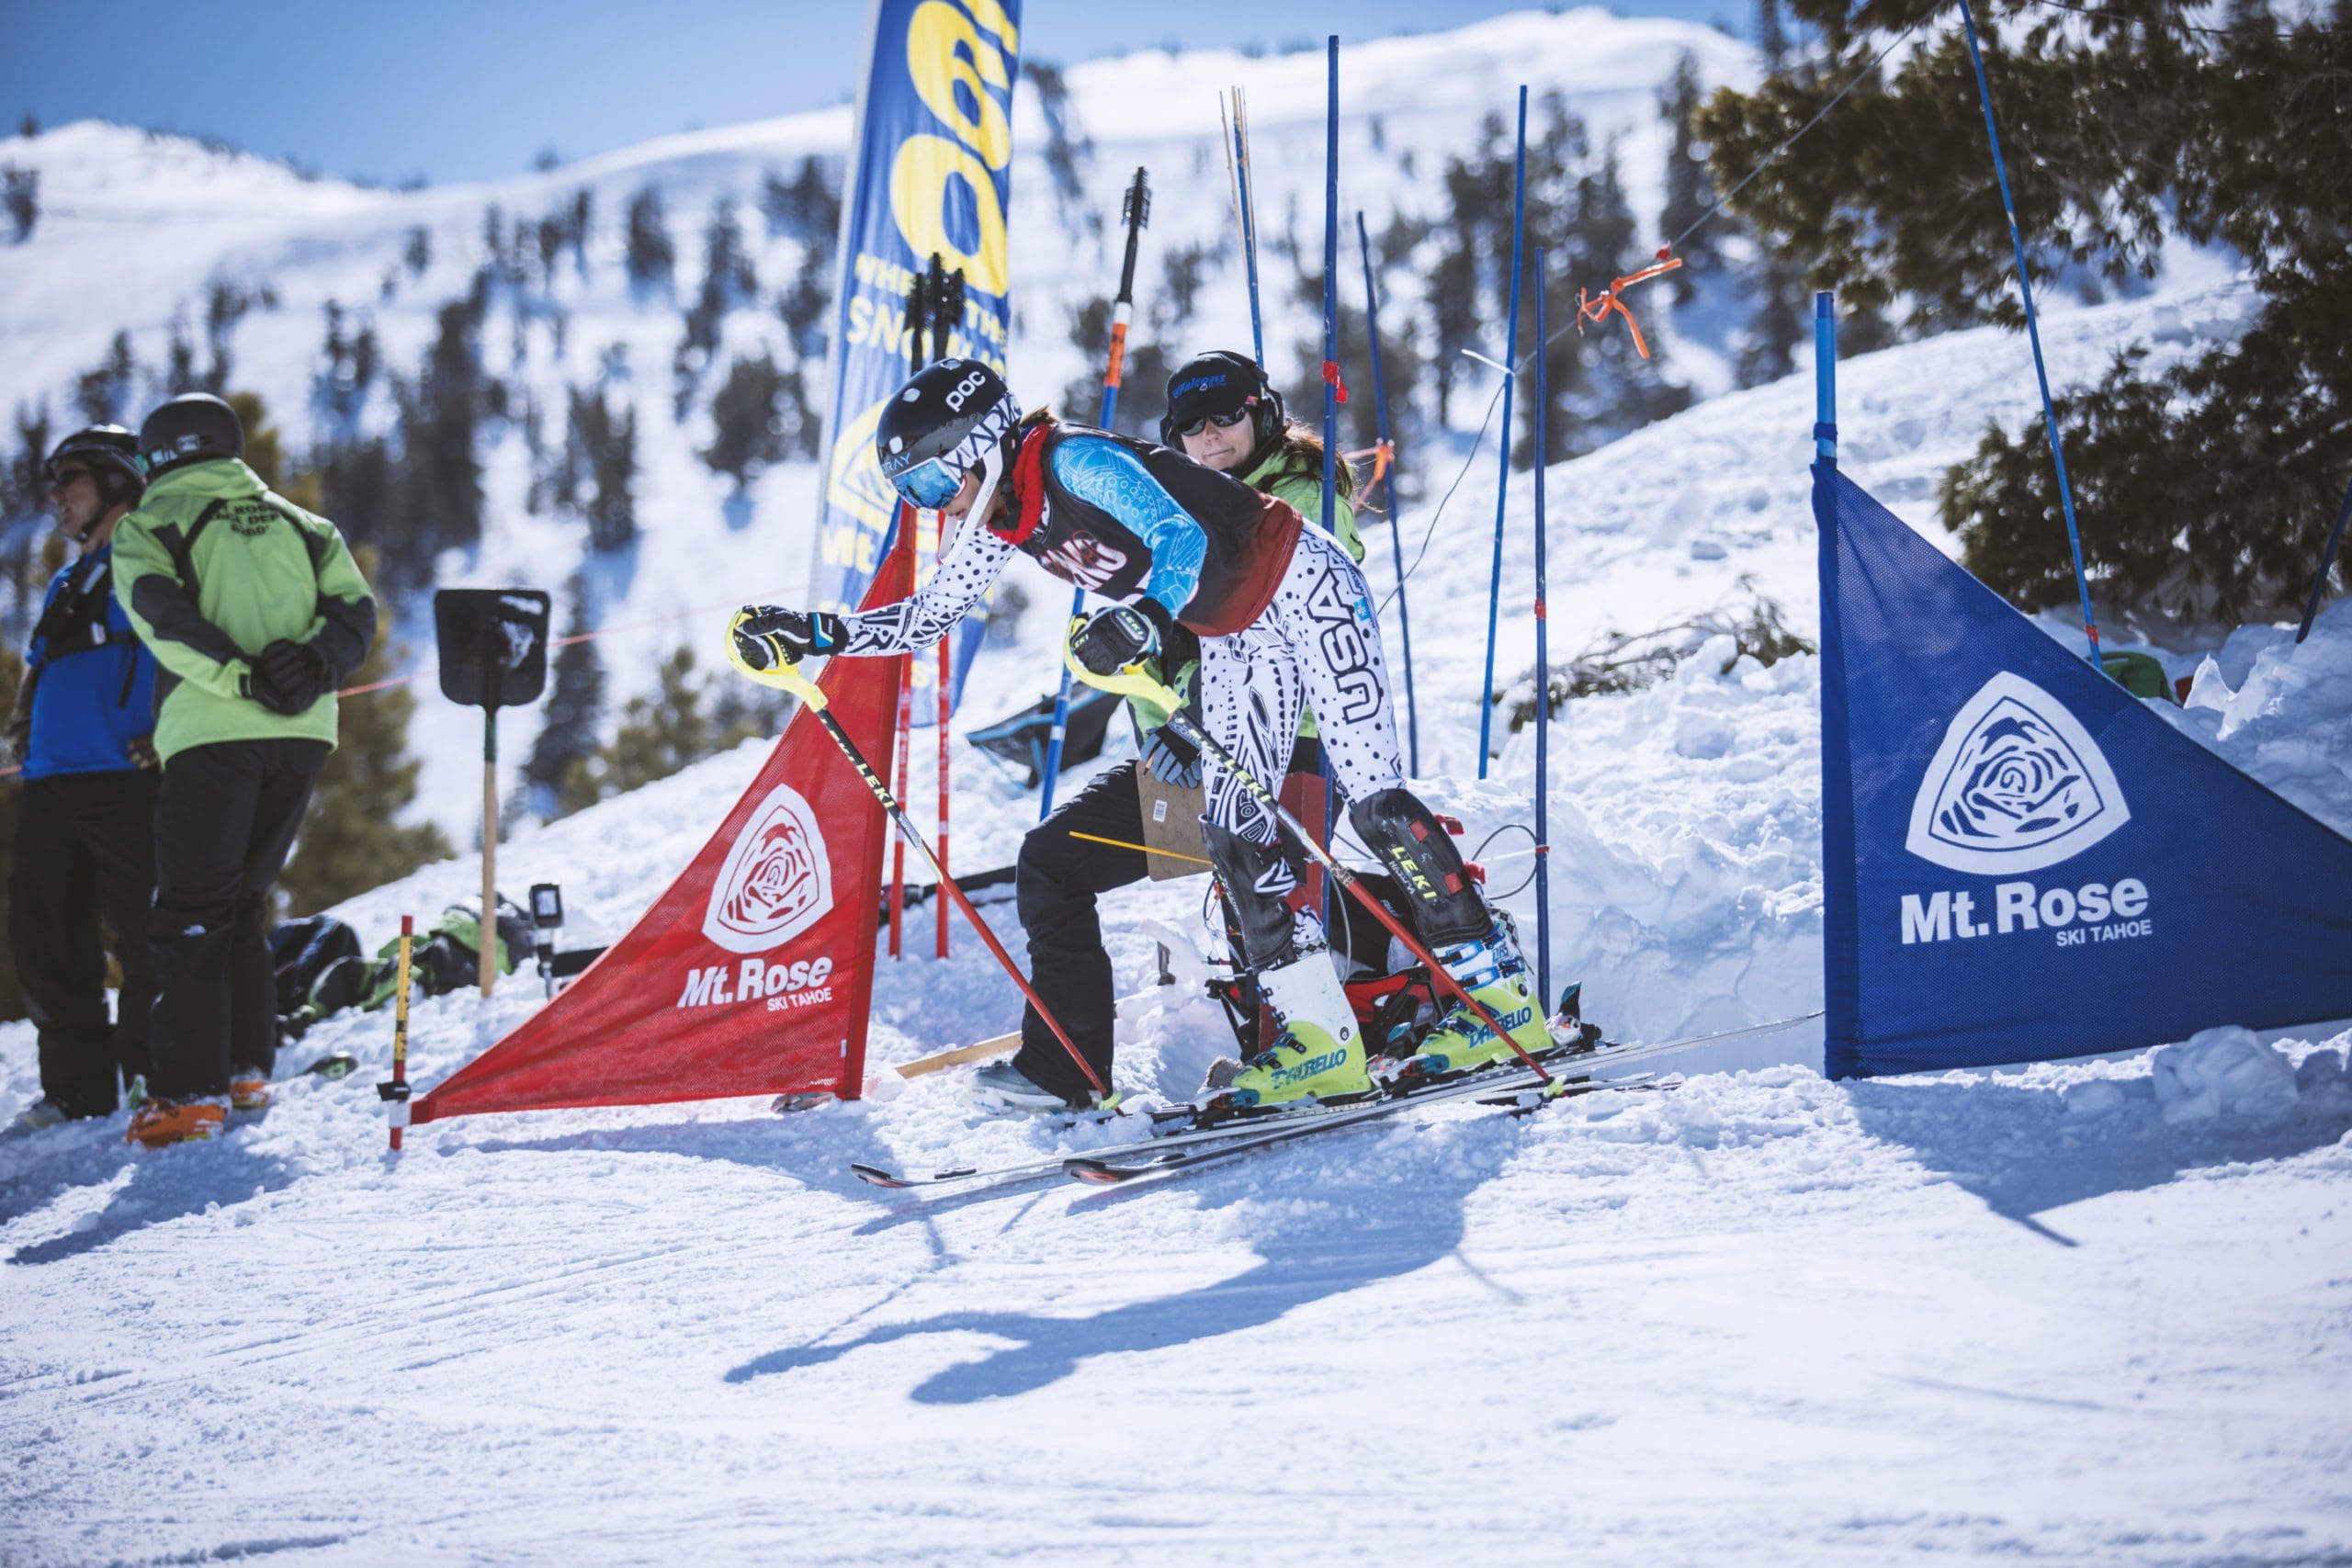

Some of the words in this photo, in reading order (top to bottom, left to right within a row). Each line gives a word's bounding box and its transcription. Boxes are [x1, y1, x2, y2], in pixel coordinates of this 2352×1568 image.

[1306, 567, 1384, 725] USA
[855, 762, 896, 807] LEKI
[1224, 759, 1272, 803] LEKI
[1392, 846, 1437, 898] LEKI
[1995, 877, 2149, 934] Rose
[2055, 928, 2086, 947] SKI
[2089, 919, 2153, 942] TAHOE
[736, 956, 833, 1002] Rose
[766, 994, 789, 1012] SKI
[788, 987, 833, 1008] TAHOE
